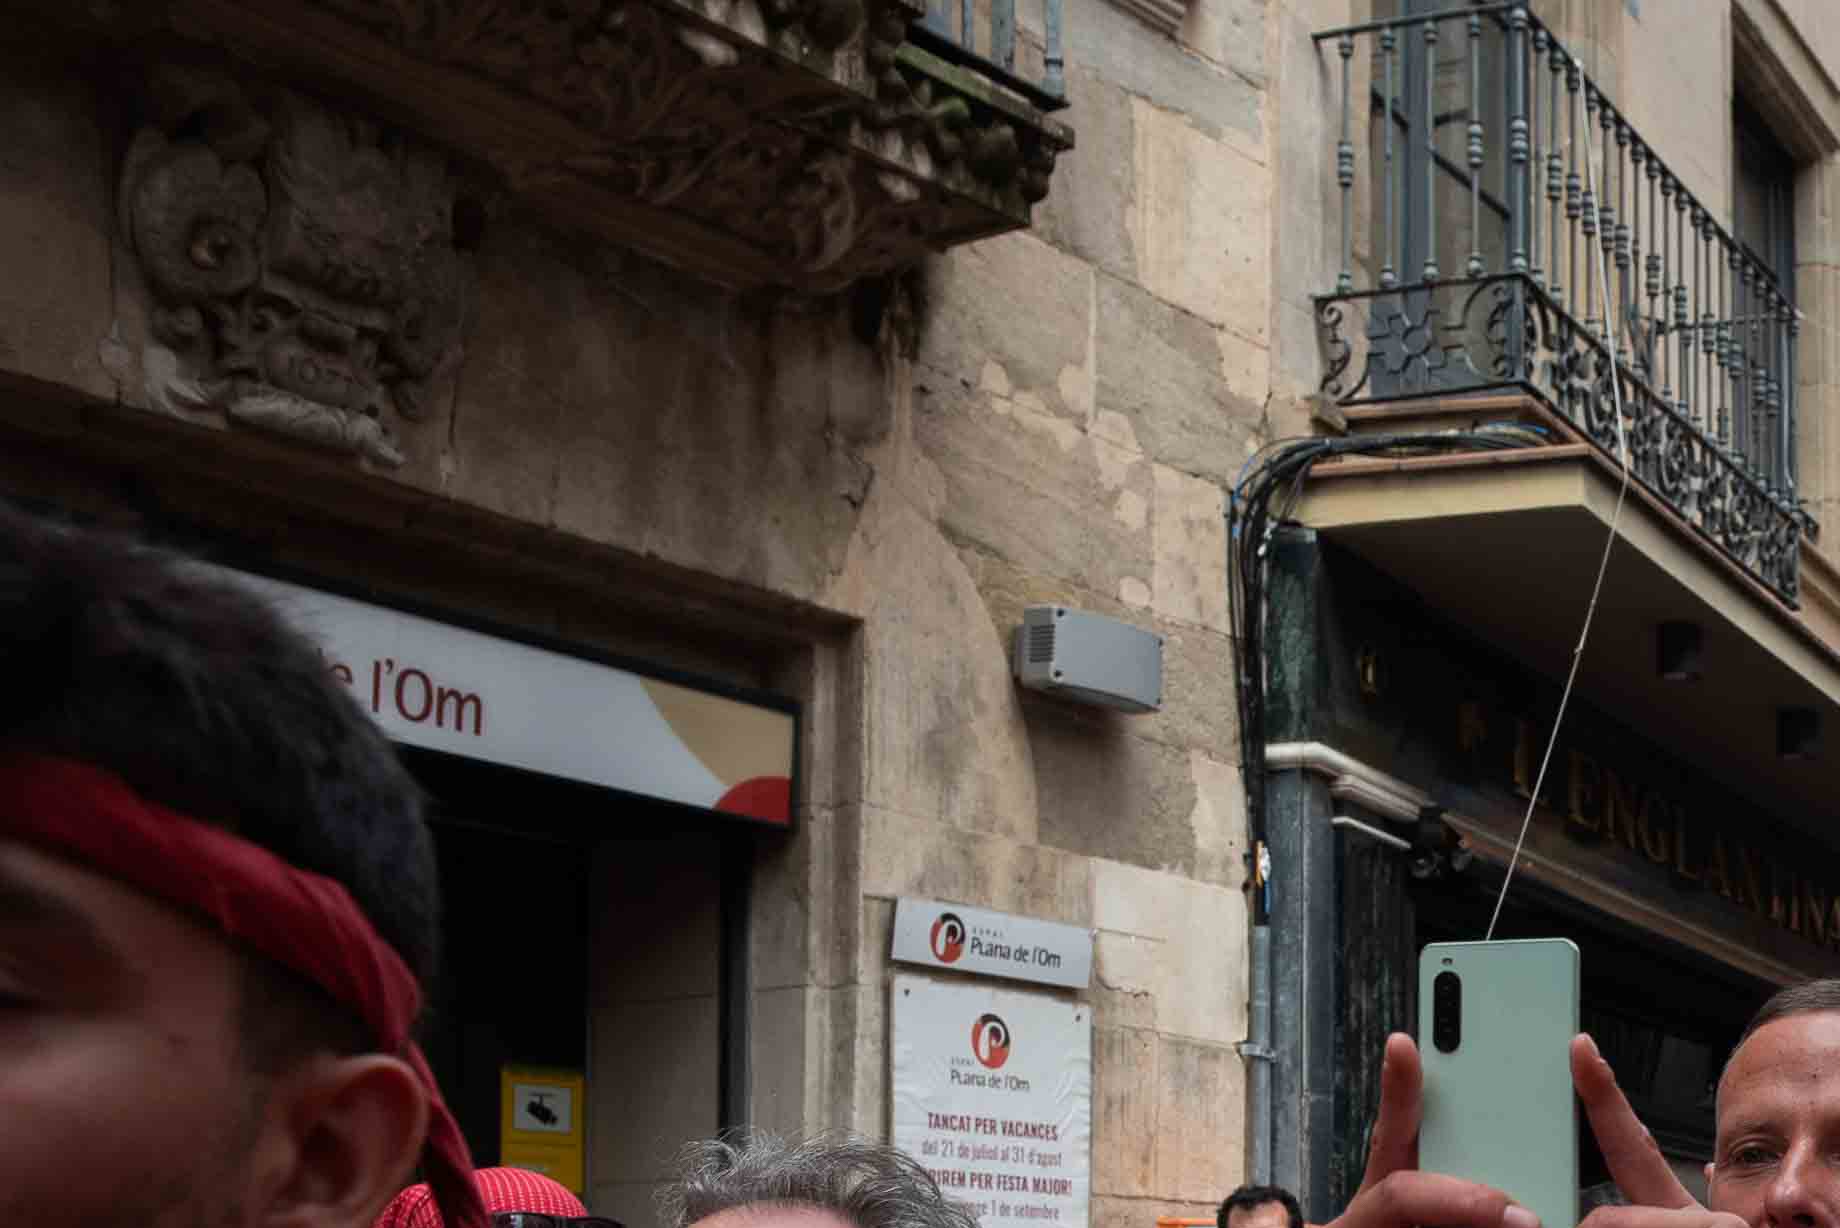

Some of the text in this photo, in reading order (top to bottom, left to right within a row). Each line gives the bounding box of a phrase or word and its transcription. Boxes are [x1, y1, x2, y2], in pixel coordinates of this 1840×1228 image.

[371, 659, 482, 736] l'Om
[1013, 944, 1029, 963] de
[987, 1074, 1003, 1089] de
[928, 1112, 1058, 1142] TANCAT PER VACANCES
[941, 1138, 954, 1158] 21
[1011, 1145, 1025, 1164] 31
[970, 1171, 993, 1191] PER
[996, 1172, 1028, 1193] FESTA
[1032, 1176, 1073, 1196] MAJOR!
